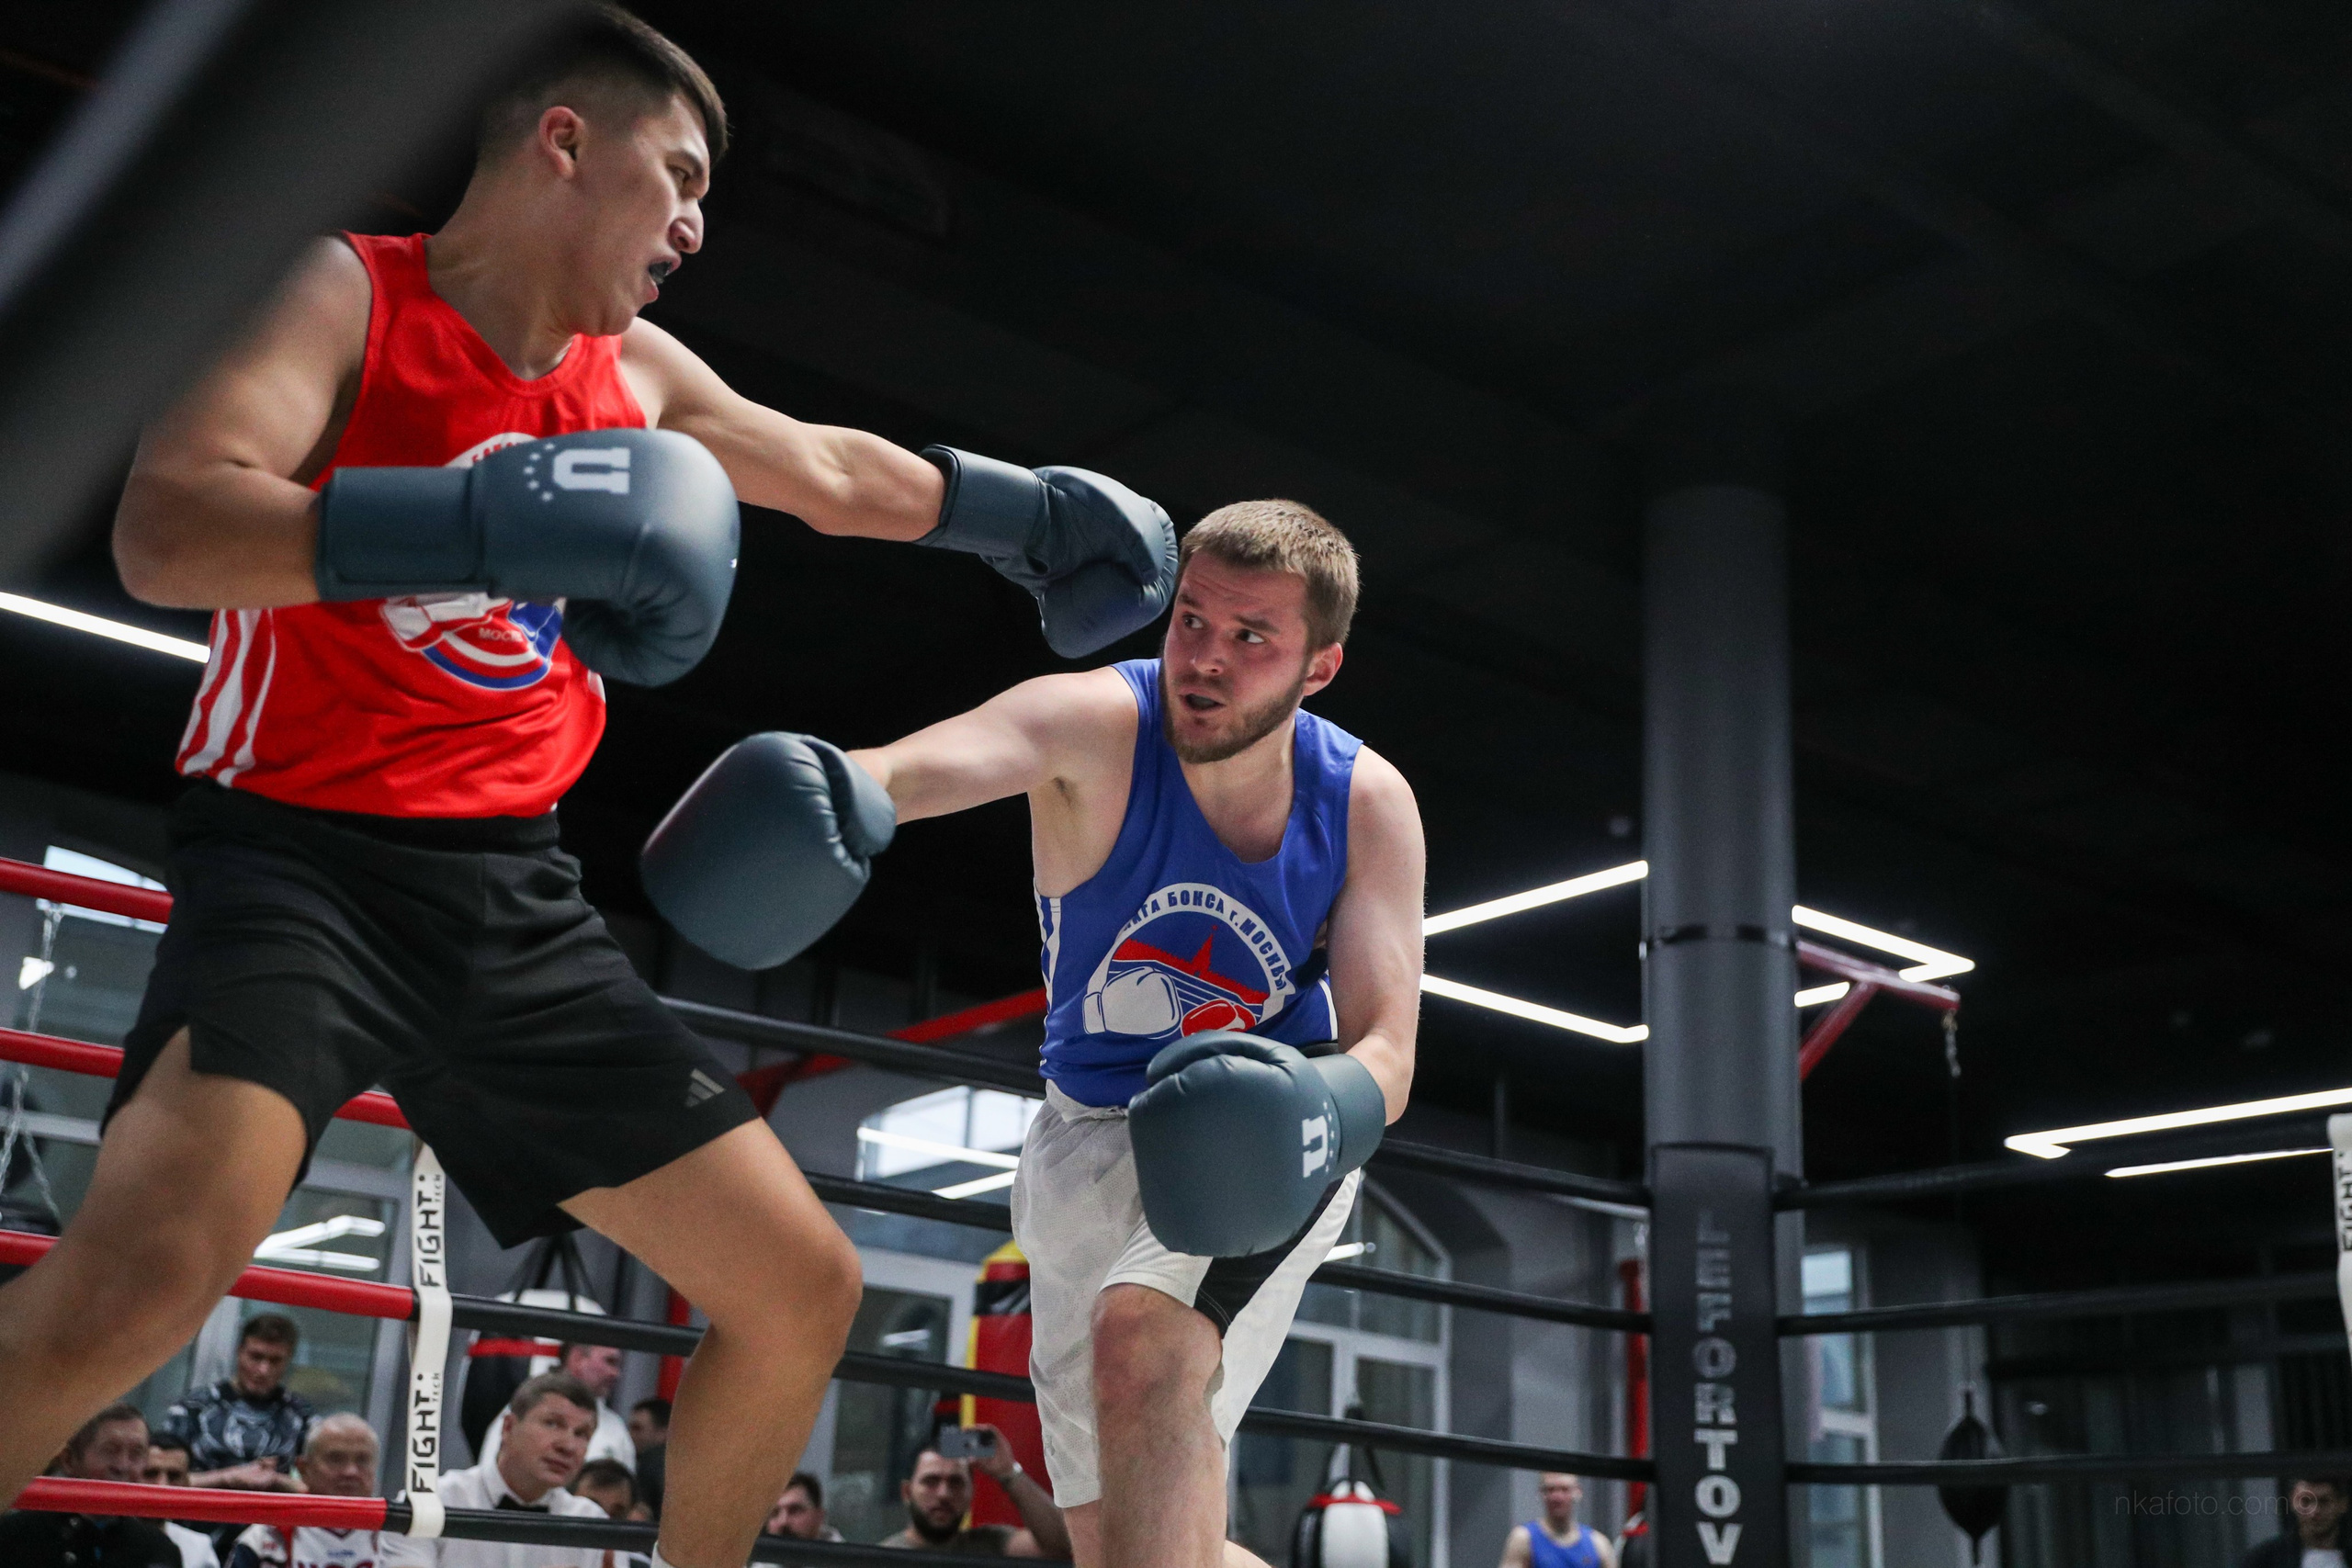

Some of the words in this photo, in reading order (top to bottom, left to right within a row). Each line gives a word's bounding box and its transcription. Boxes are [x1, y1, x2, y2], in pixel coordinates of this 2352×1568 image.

[1167, 889, 1225, 915] БОКСА
[417, 1190, 441, 1288] FIGHT
[412, 1389, 436, 1494] FIGHT
